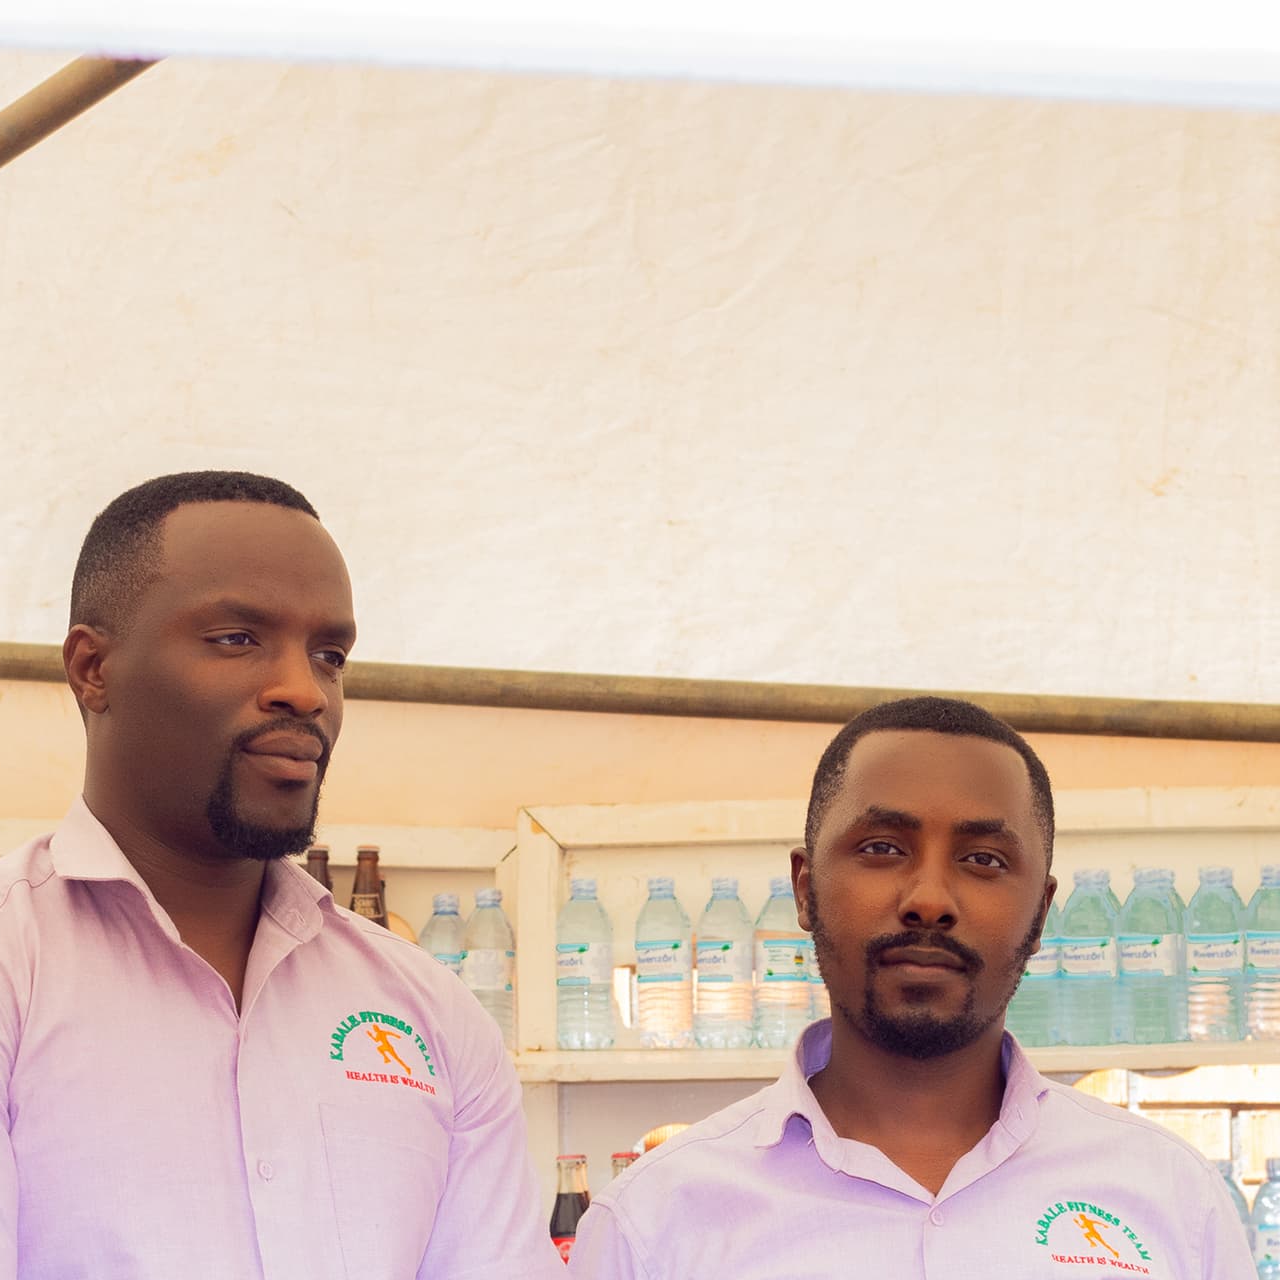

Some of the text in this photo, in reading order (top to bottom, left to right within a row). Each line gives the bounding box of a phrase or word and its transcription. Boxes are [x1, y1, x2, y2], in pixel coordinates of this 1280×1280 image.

[359, 1011, 413, 1035] FITNESS
[345, 1070, 436, 1095] HEALTH IS WEALTH
[1035, 1202, 1067, 1246] KABALE
[1066, 1201, 1120, 1226] FITNESS
[1051, 1253, 1150, 1274] HEALTH IS WEALTH
